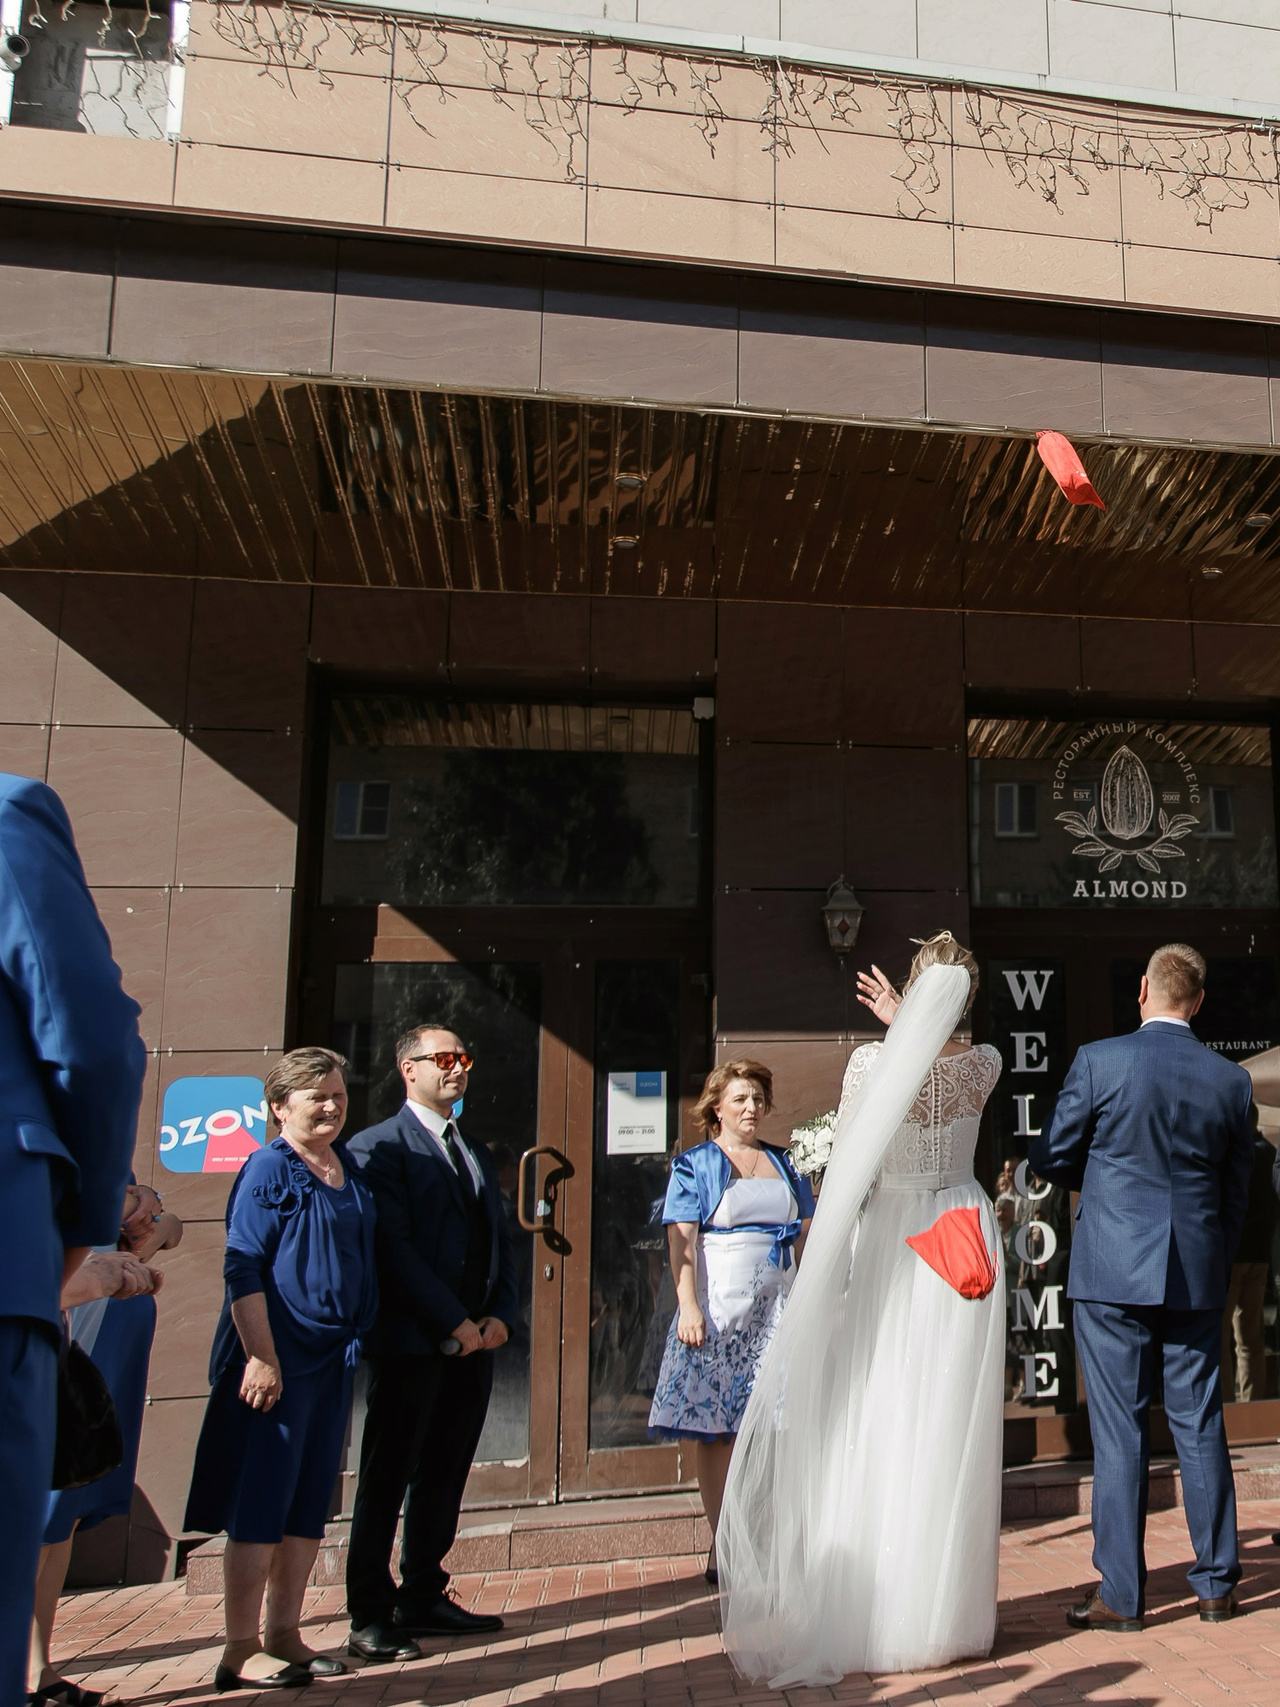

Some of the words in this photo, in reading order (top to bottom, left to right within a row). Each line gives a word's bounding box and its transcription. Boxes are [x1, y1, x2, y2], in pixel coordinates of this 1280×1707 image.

[1053, 721, 1137, 800] РЕСТОРАННЫЙ
[1145, 727, 1200, 804] КОМПЛЕКС
[1073, 791, 1091, 799] EST.
[1162, 794, 1180, 802] 2007
[1072, 880, 1187, 899] ALMOND
[1202, 1041, 1271, 1051] ESTAURANT
[1002, 970, 1065, 1398] WELCOME
